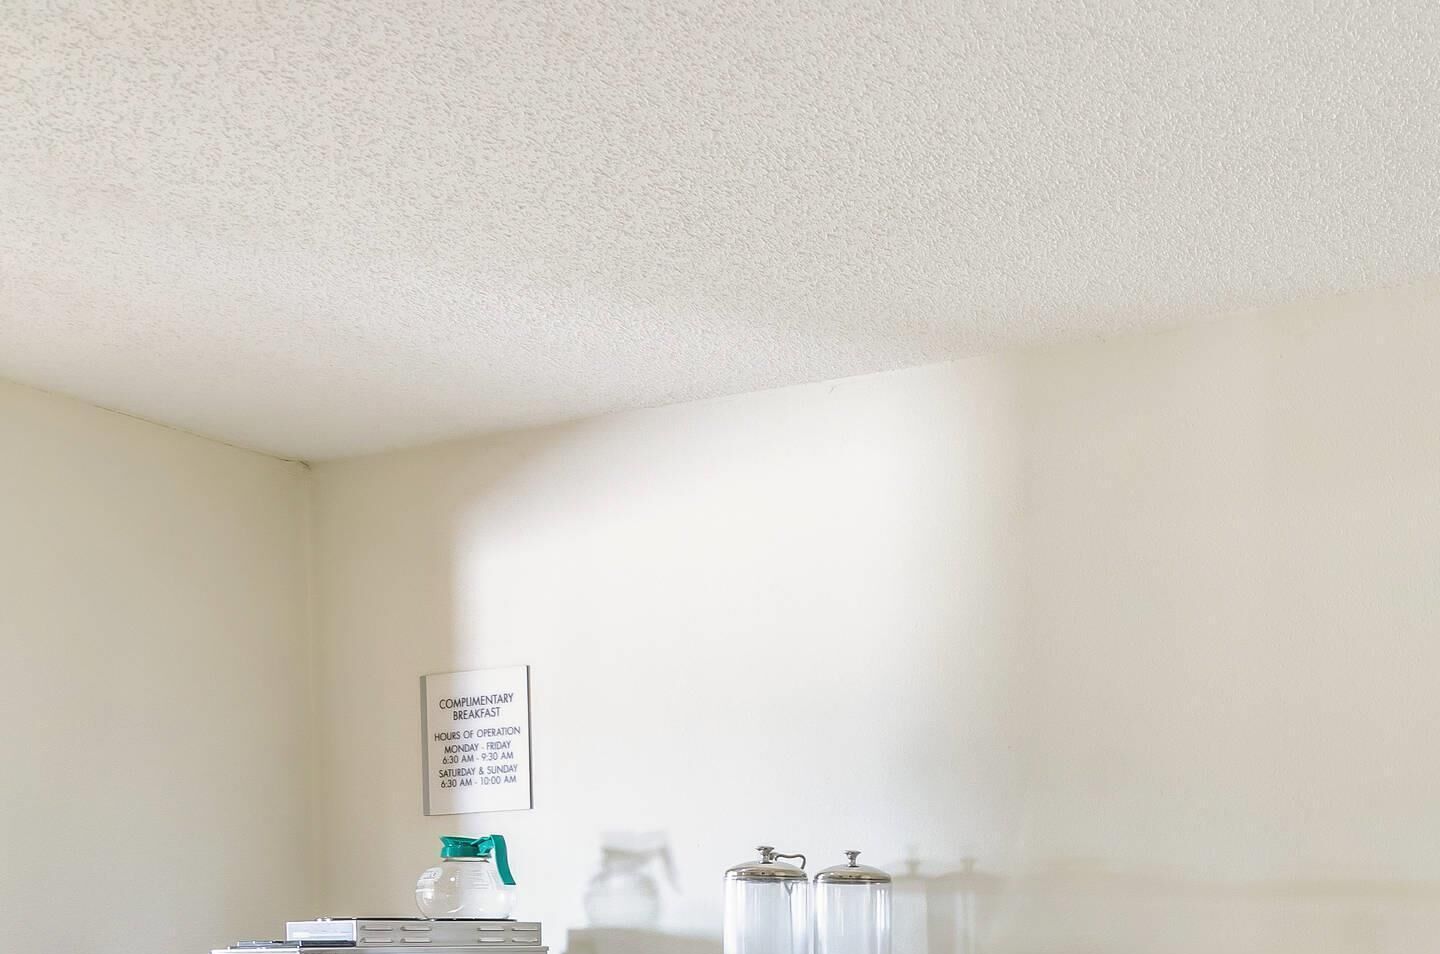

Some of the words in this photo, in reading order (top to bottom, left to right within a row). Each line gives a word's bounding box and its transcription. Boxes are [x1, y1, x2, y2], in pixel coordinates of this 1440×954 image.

[439, 693, 514, 709] COMPLIMENTARY
[453, 708, 501, 720] BREAKFAST
[434, 731, 461, 742] HOURS
[463, 731, 474, 739] OF
[477, 727, 521, 738] OPERATION
[444, 744, 479, 754] MONDAY
[486, 741, 512, 751] FRIDAY
[442, 756, 458, 764] 6:30
[439, 768, 476, 778] SATURDAY
[487, 765, 518, 775] SUNDAY
[480, 777, 501, 785] 10:00
